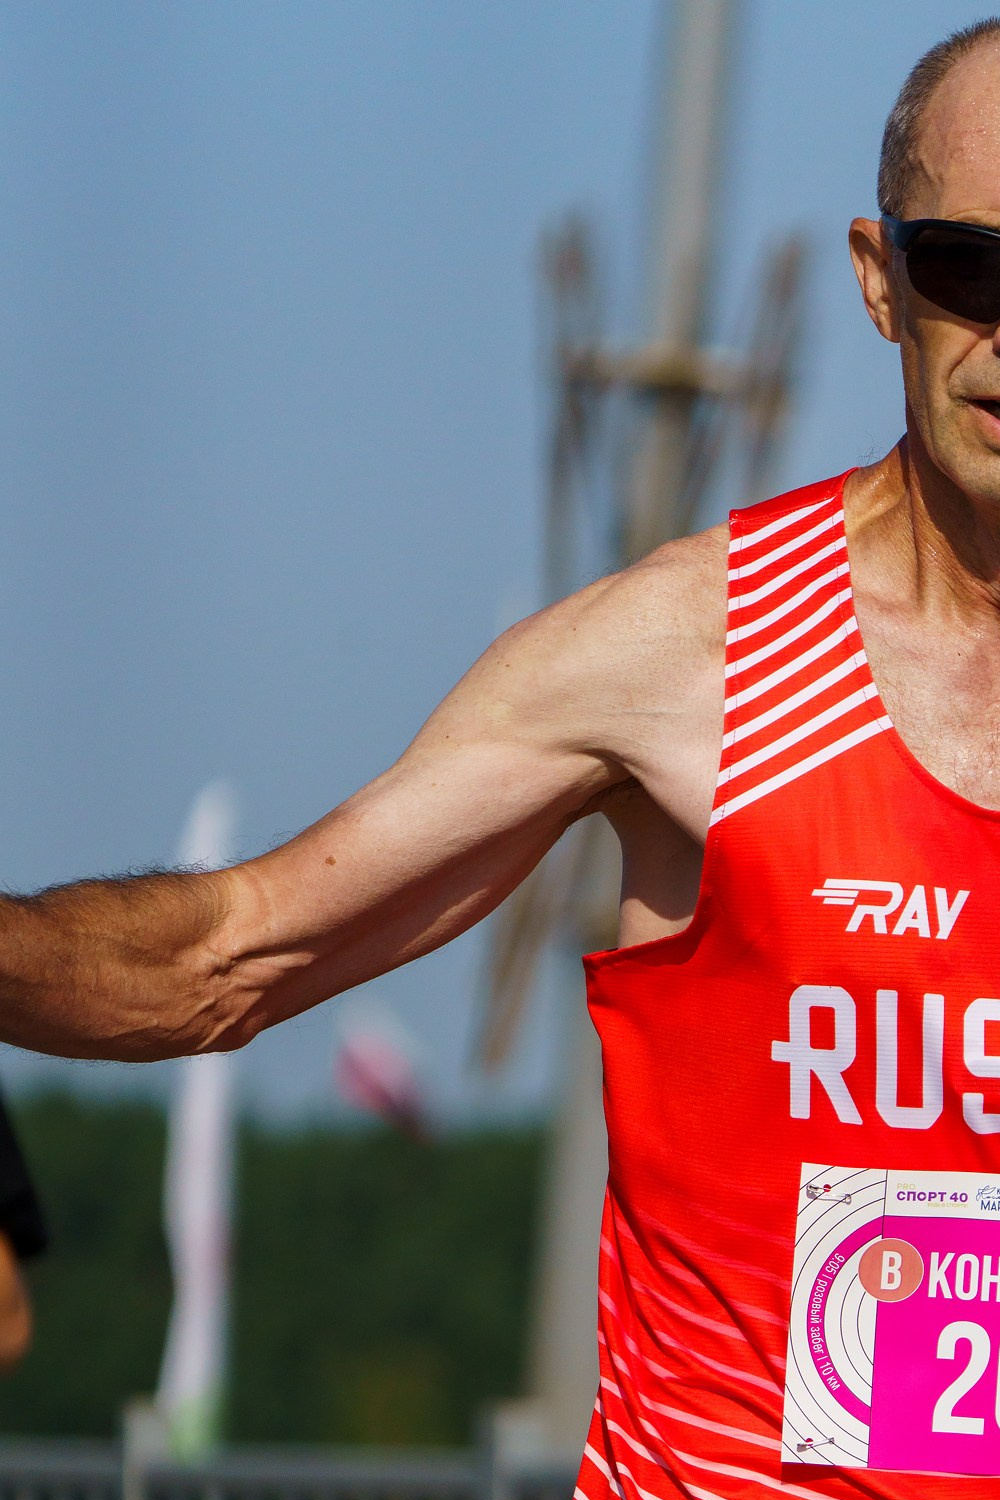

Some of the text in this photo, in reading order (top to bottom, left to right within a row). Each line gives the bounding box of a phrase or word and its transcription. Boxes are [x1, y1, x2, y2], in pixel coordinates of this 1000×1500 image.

[811, 877, 971, 940] RAY
[896, 1183, 916, 1191] PRO
[896, 1190, 969, 1203] СПОРТ 40
[825, 1252, 845, 1275] 9:05
[810, 1278, 828, 1324] розовый
[810, 1326, 824, 1354] забег
[820, 1361, 834, 1376] 10
